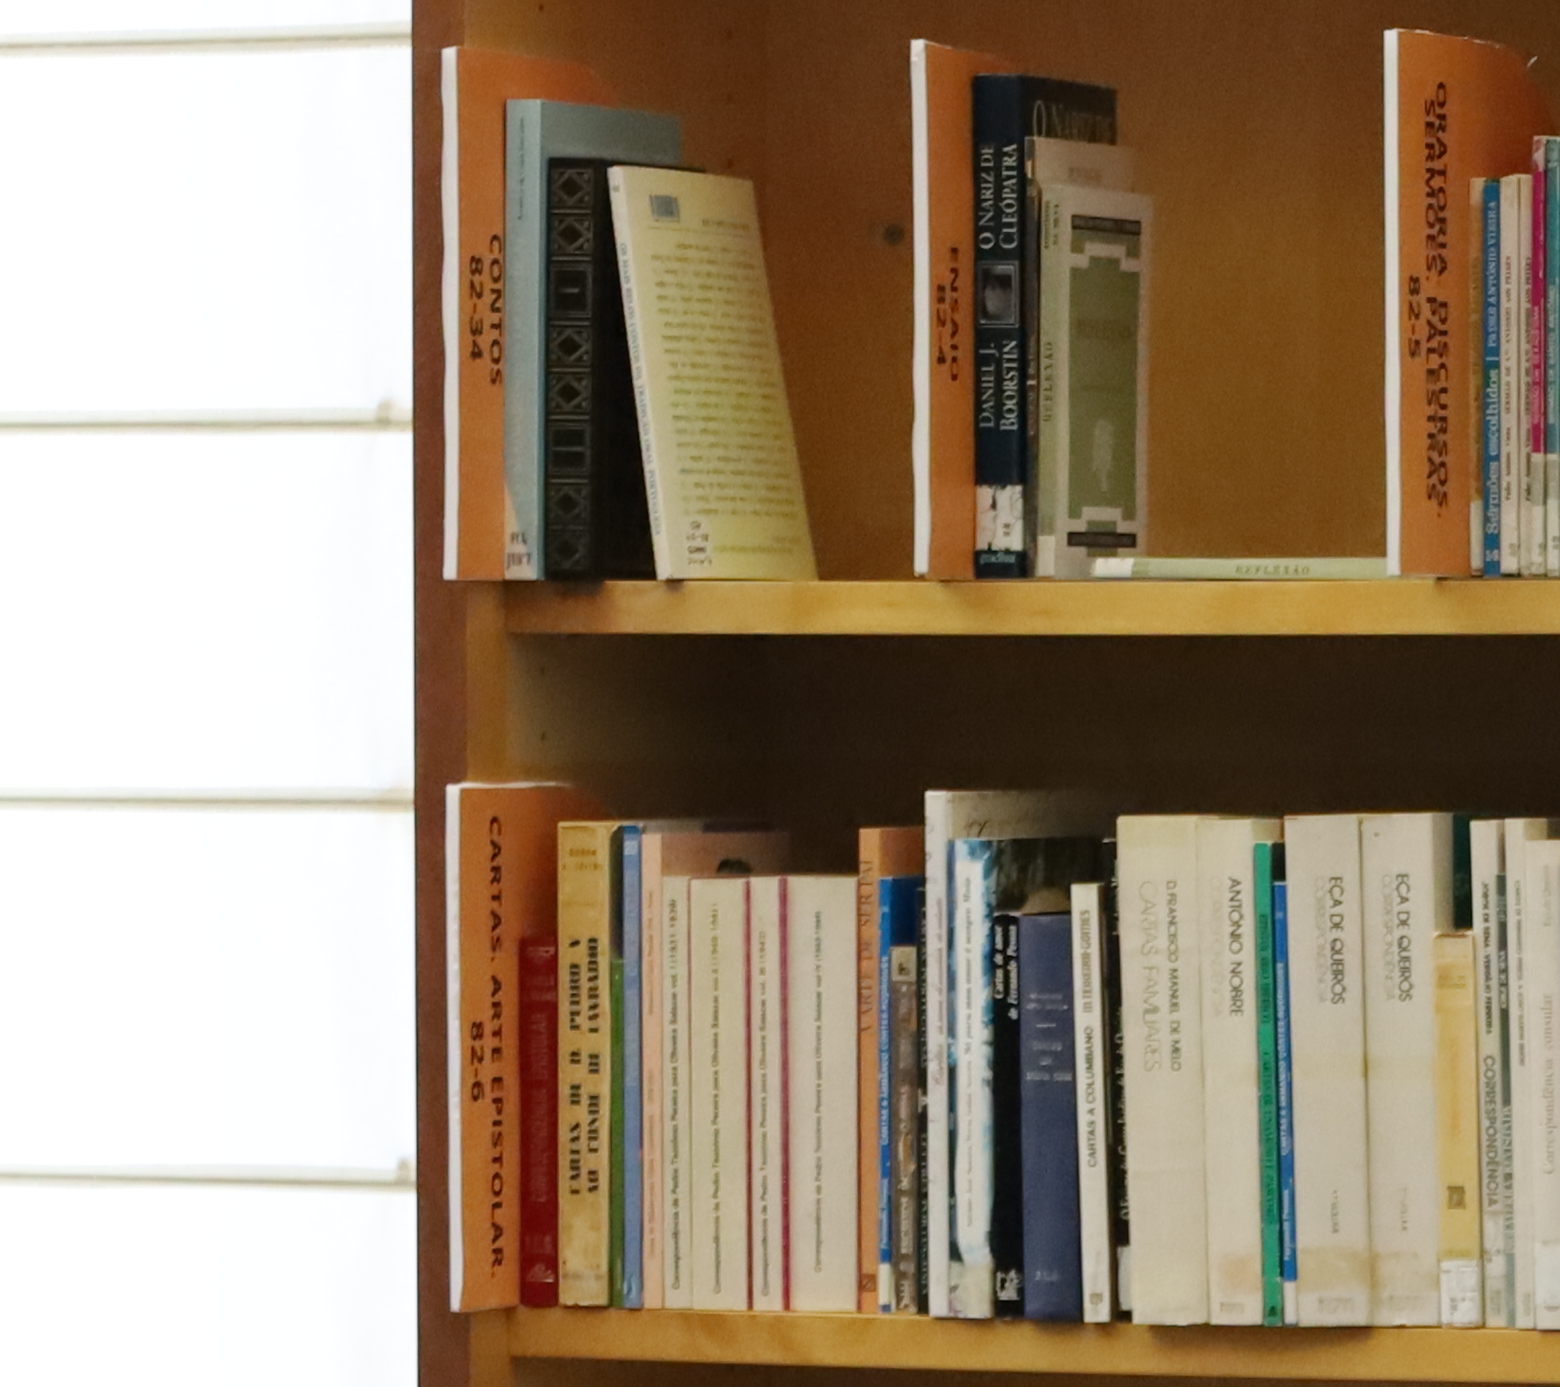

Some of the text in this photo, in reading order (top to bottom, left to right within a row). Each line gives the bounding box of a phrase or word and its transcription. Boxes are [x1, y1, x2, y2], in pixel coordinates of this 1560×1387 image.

[978, 146, 995, 249] O NARIZ DE
[1000, 144, 1018, 249] CLEÓPATRA
[470, 255, 483, 360] 82-34
[490, 234, 502, 384] CONTOS
[980, 363, 994, 428] DANIEL
[1000, 340, 1018, 430] BOORSTIN
[1329, 914, 1344, 933] DE
[471, 1021, 484, 1102] 82-6
[489, 816, 504, 1279] CARTAS. ARTE EPISTOLAR.
